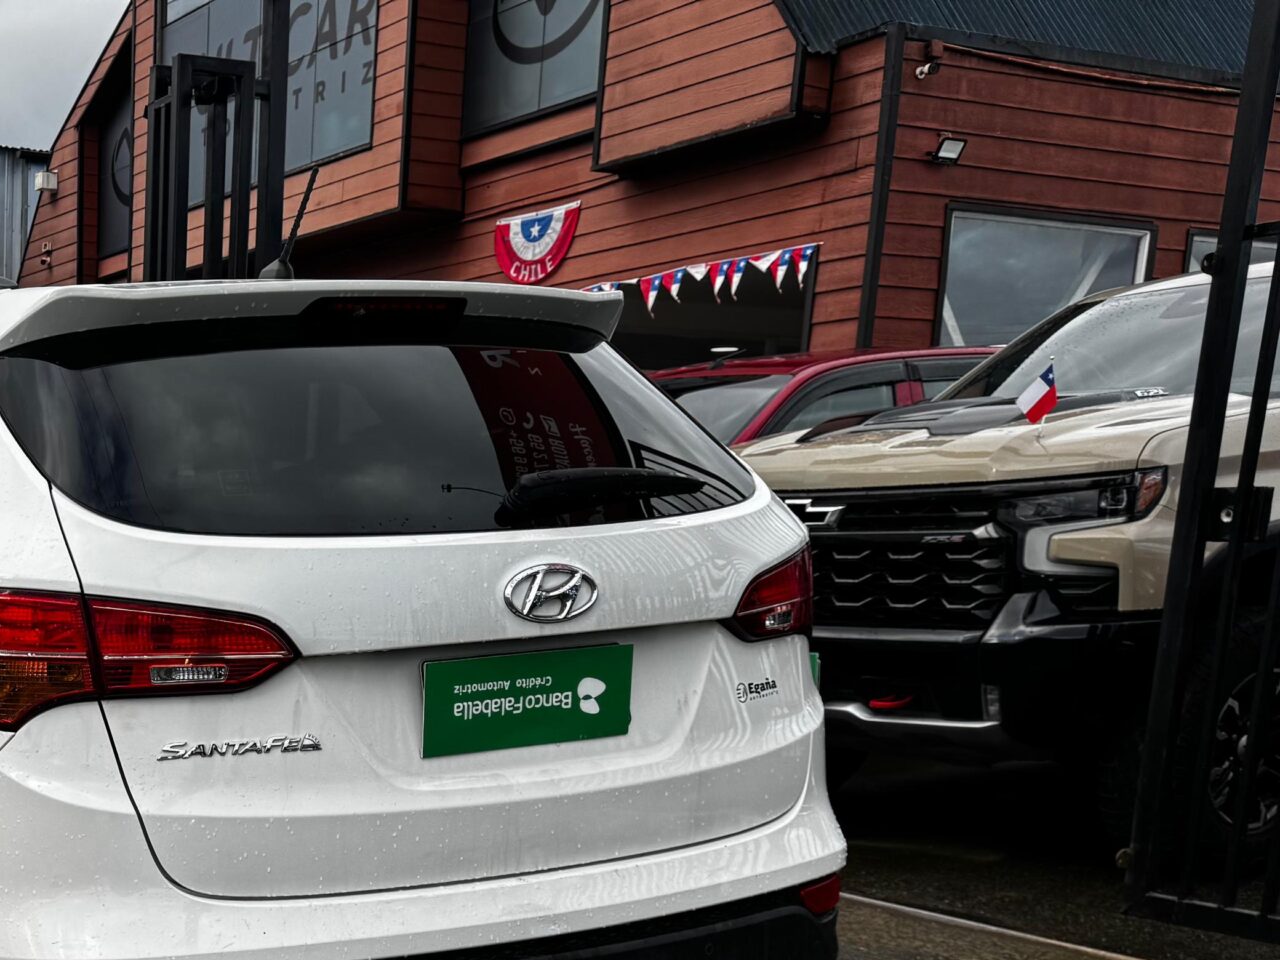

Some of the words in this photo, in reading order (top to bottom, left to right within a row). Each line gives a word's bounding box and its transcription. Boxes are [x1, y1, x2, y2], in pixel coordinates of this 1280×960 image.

[510, 255, 554, 282] CHILE
[453, 679, 511, 695] Automotriz
[516, 675, 552, 689] Crédito
[747, 677, 777, 696] Egaña
